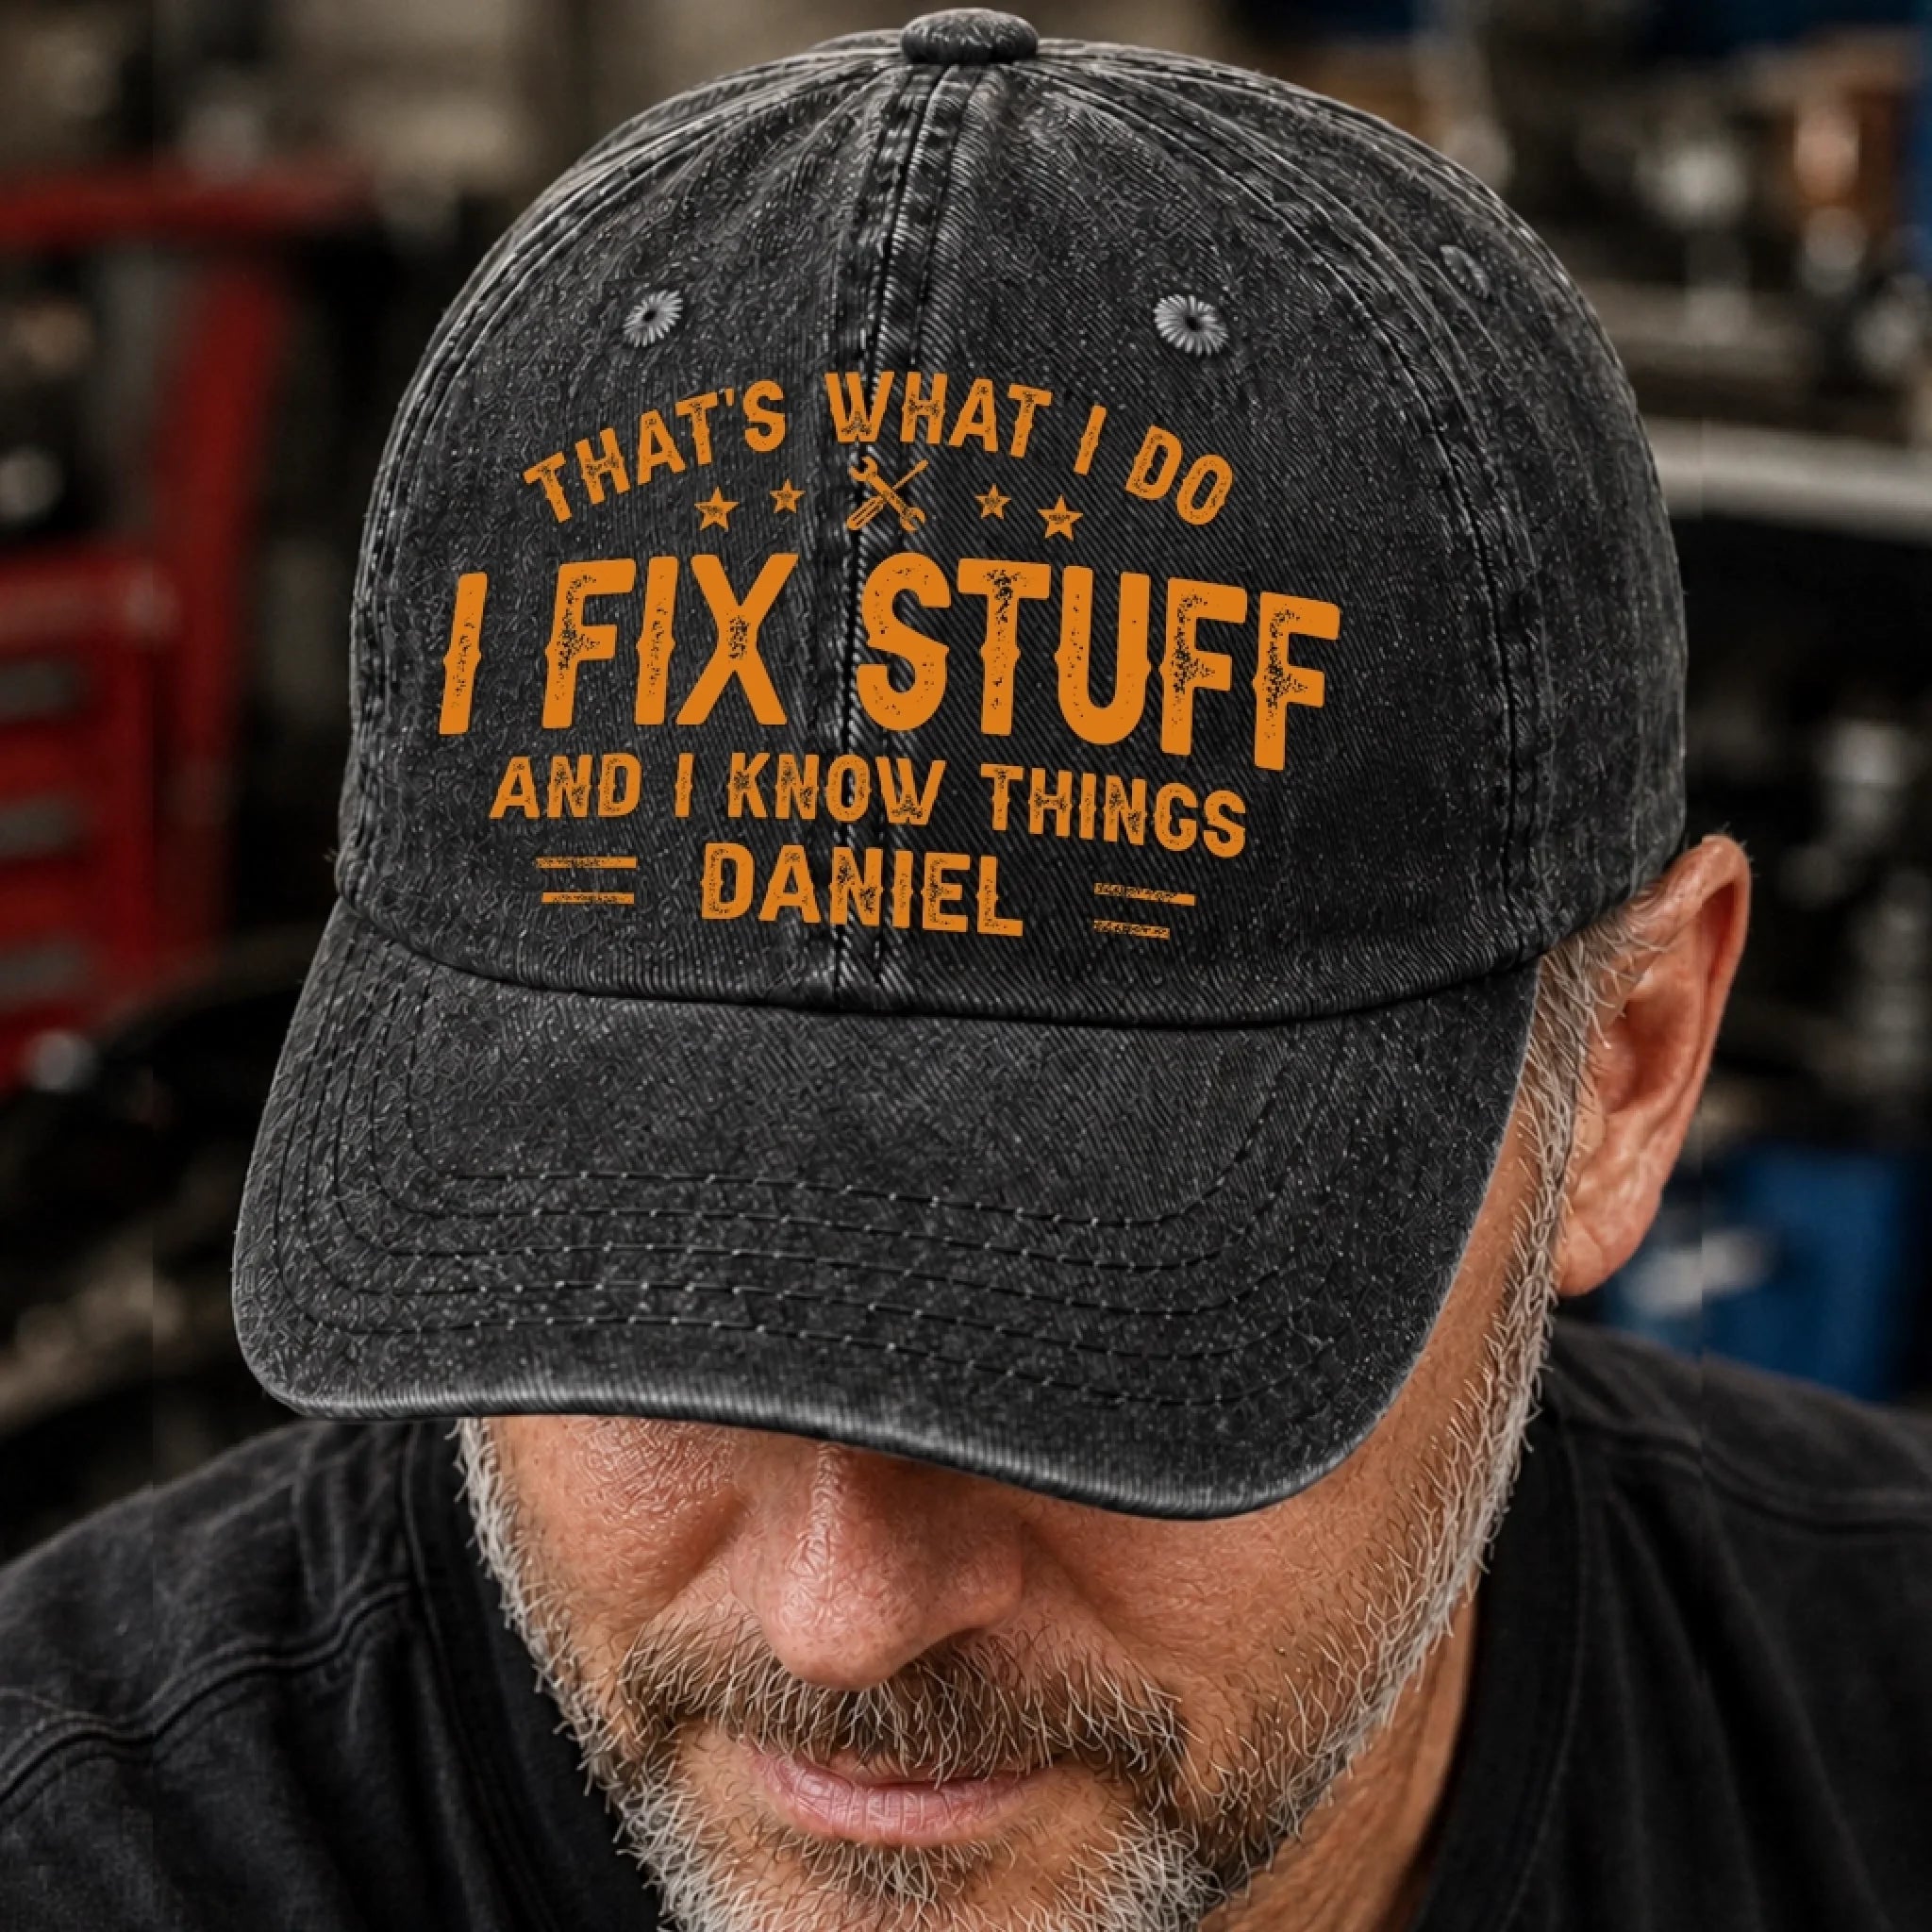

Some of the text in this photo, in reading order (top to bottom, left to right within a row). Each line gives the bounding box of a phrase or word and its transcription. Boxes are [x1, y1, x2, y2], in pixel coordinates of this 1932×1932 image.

[523, 371, 1234, 526] THAT'S WHAT I DO
[439, 551, 1341, 772] I FIX STUFF
[490, 752, 1247, 858] AND I KNOW THINGS
[700, 841, 1024, 938] DANIEL
